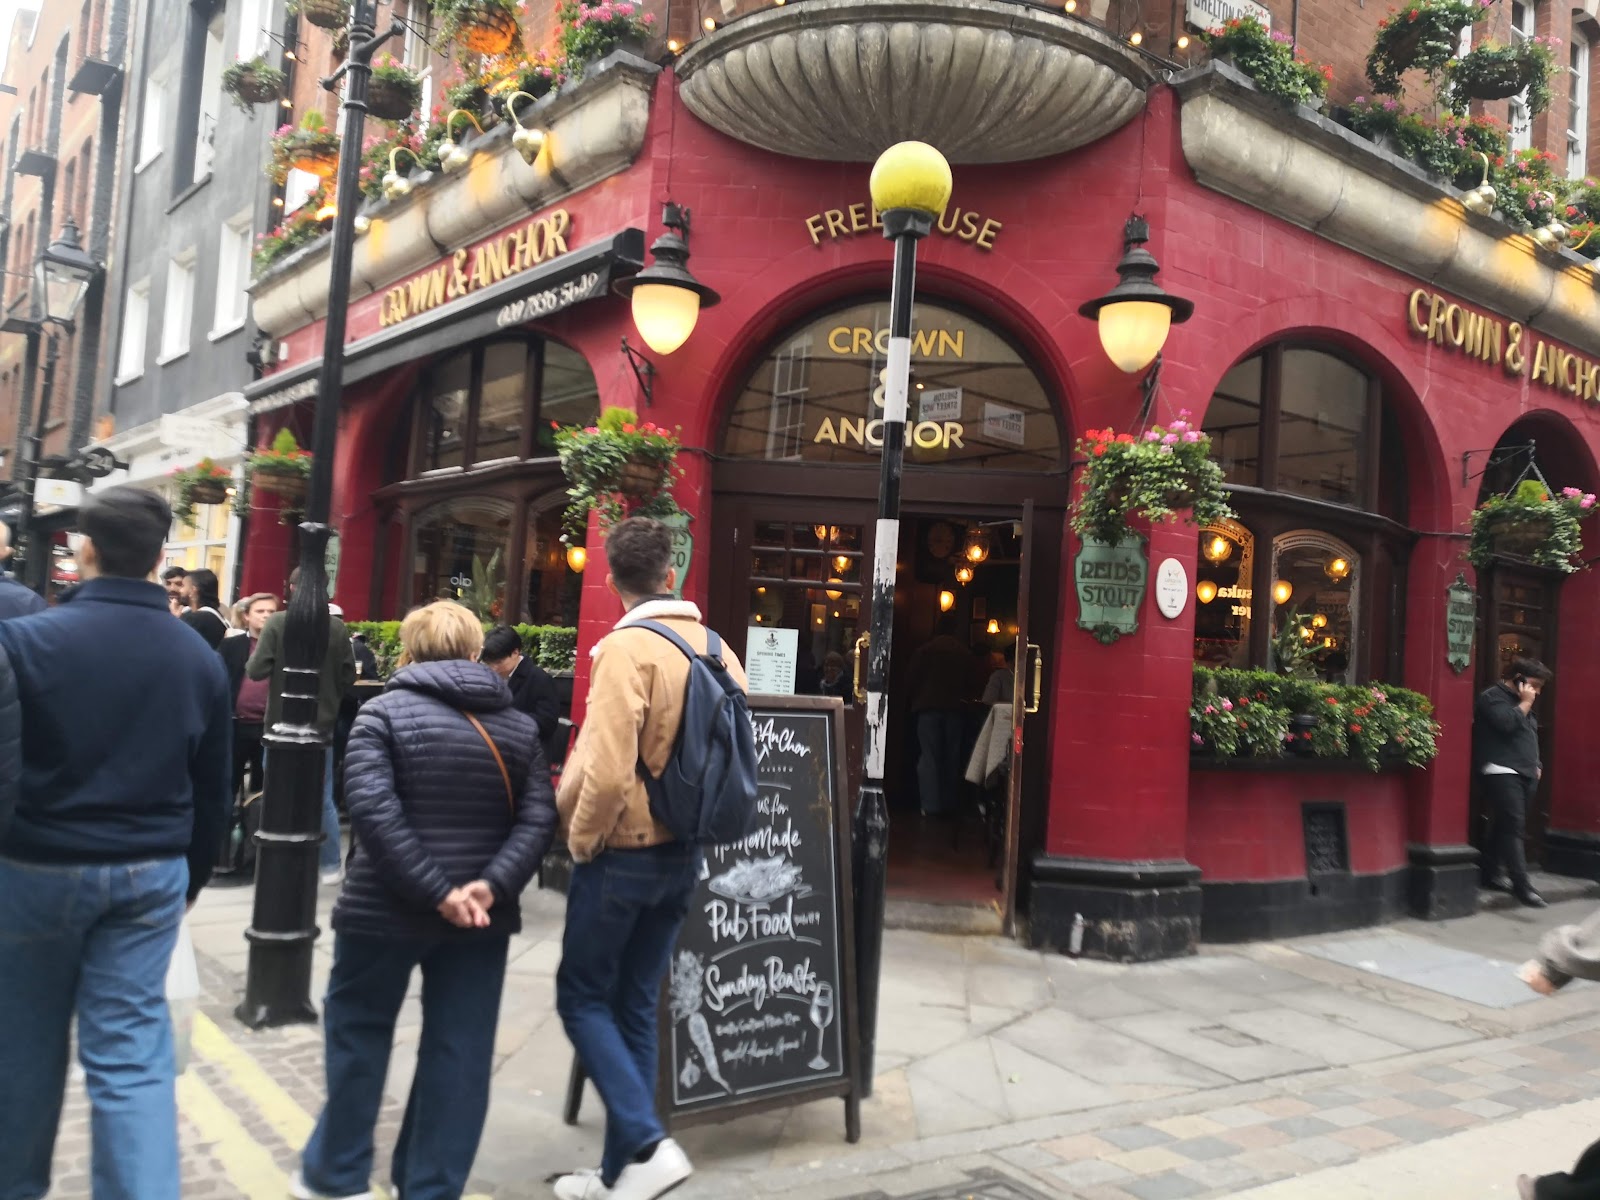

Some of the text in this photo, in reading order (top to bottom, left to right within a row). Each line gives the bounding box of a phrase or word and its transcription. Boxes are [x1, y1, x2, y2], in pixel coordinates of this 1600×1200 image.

[378, 208, 570, 327] CROWN & ANCHOR
[1409, 288, 1502, 364] CROWN
[1505, 321, 1525, 372] &
[1080, 558, 1142, 583] REID'S
[1081, 585, 1140, 608] STOUT
[704, 894, 797, 942] Pub Food
[705, 962, 767, 1011] Sunday
